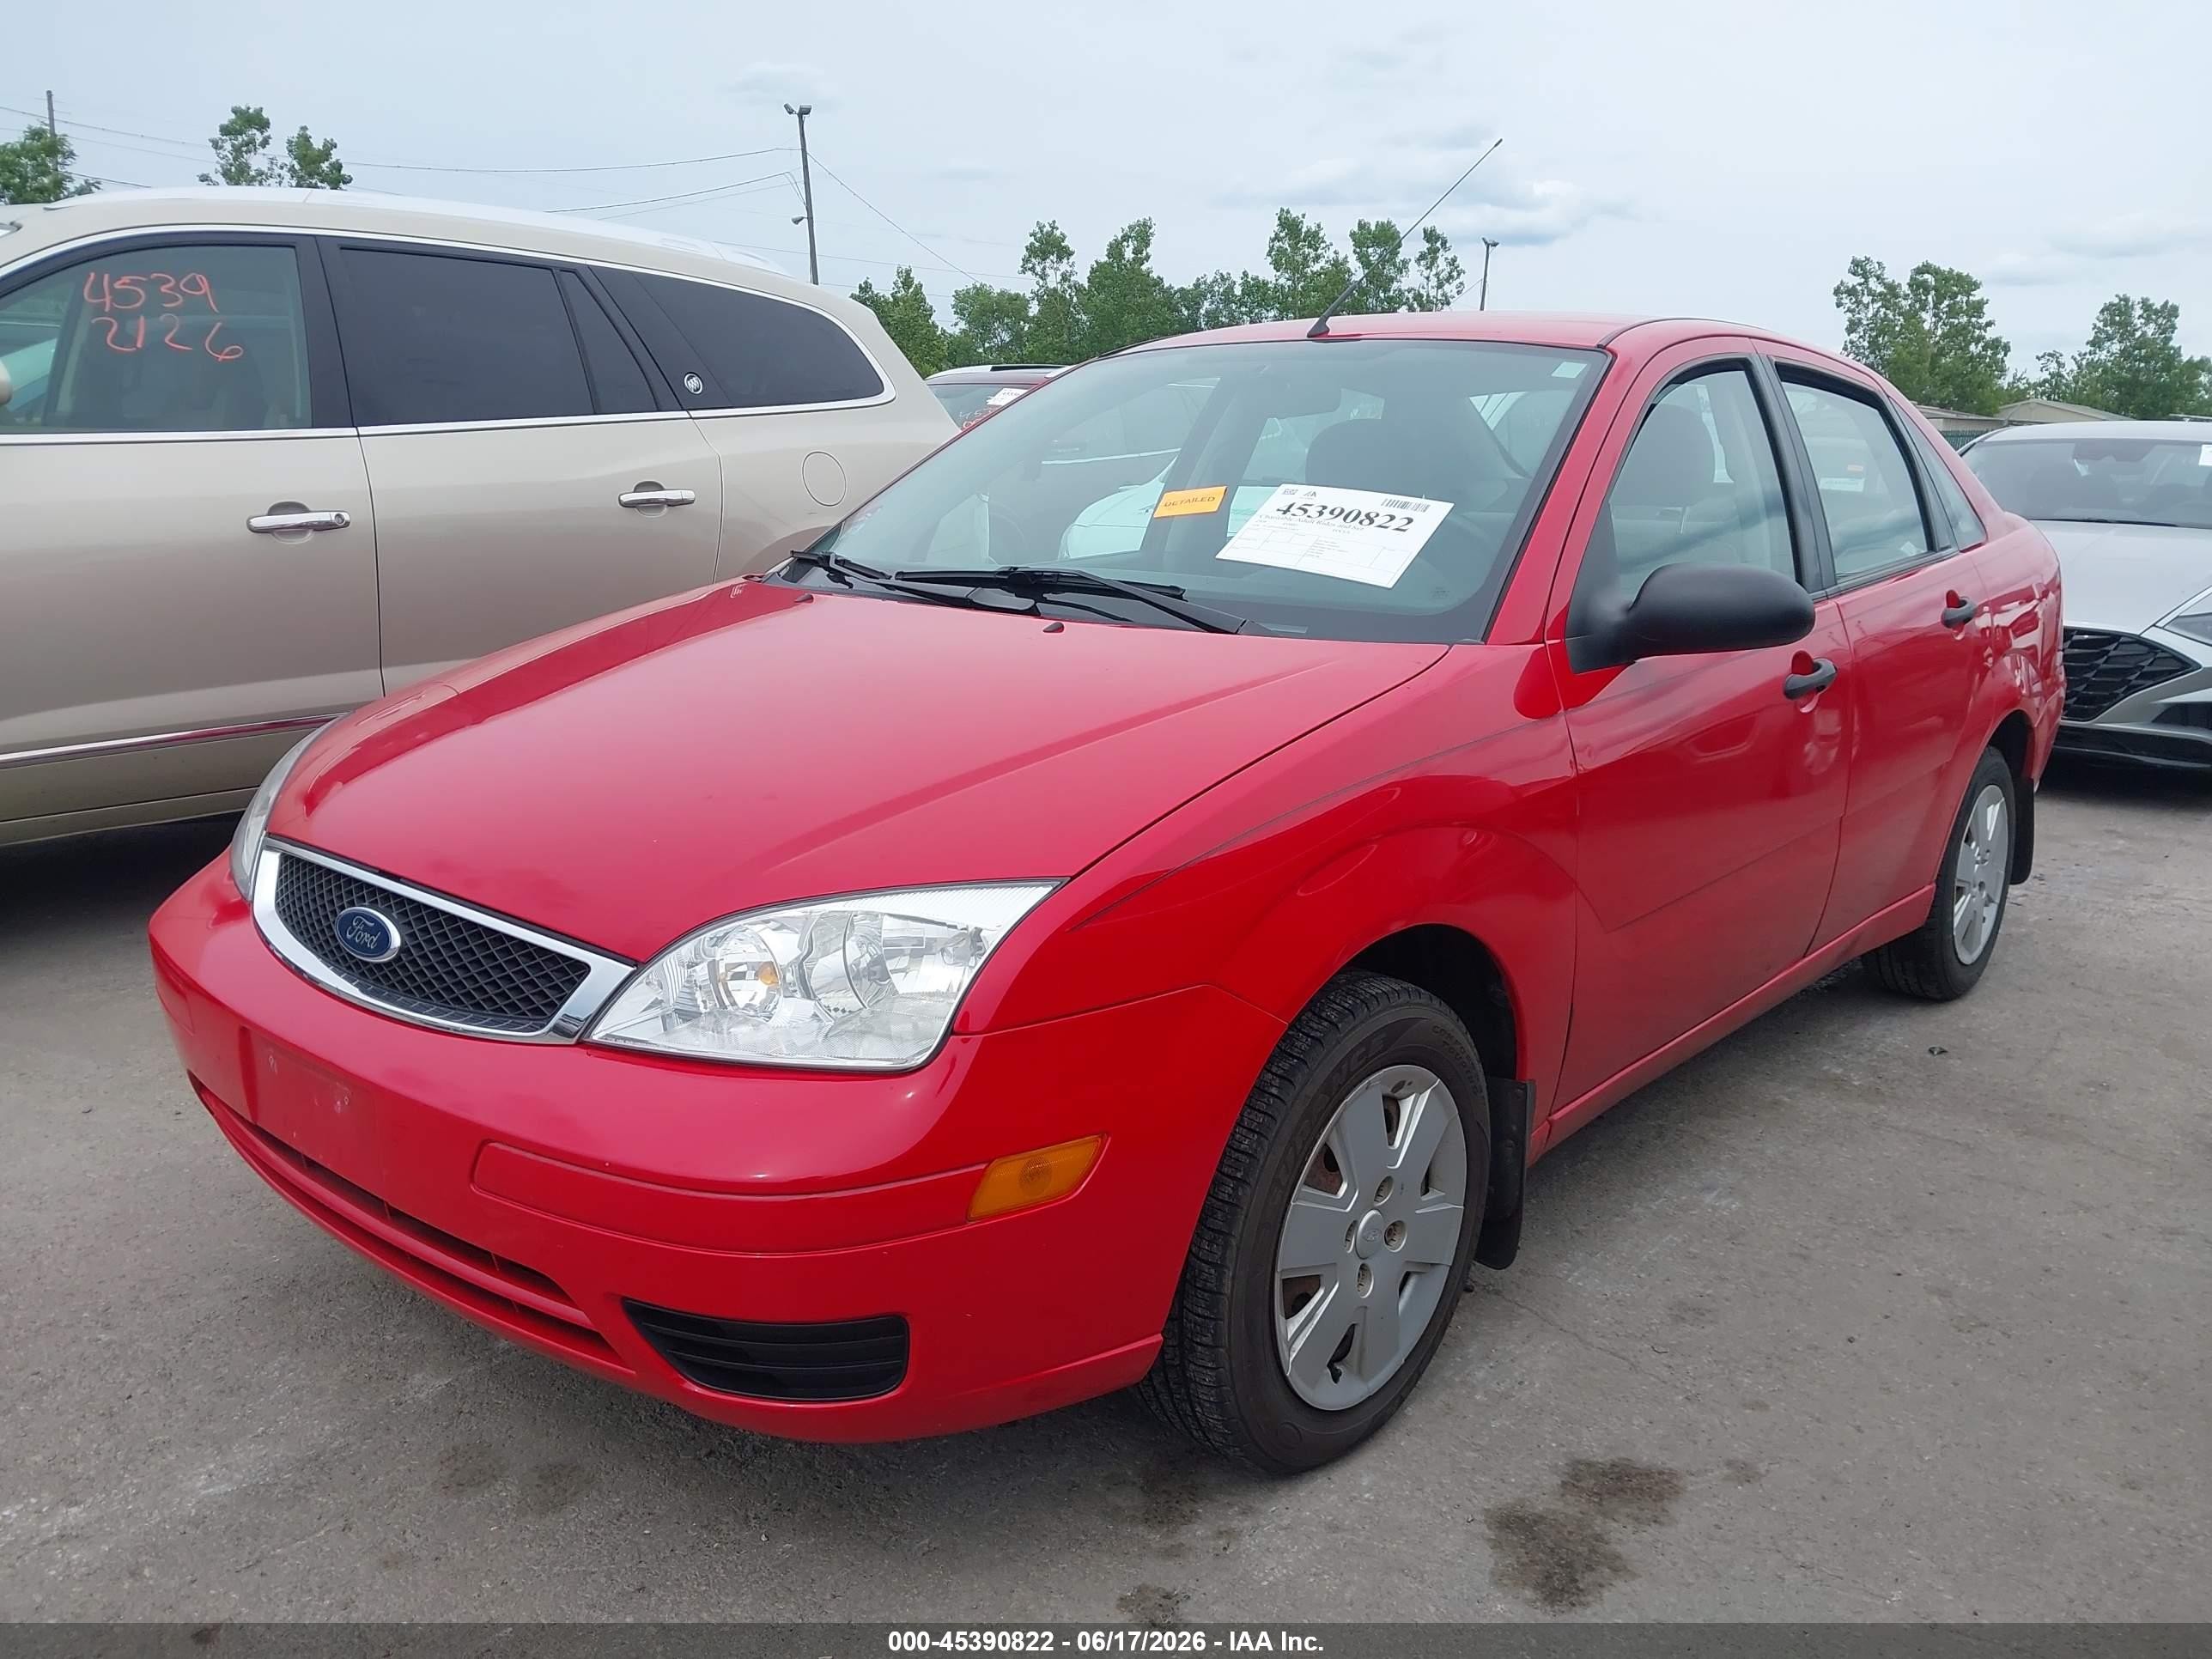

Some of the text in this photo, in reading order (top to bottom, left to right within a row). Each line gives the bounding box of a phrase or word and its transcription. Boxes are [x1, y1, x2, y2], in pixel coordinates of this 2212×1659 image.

[83, 272, 220, 313] 4539
[91, 313, 244, 362] 2126
[1164, 496, 1216, 507] DETAILED
[1275, 501, 1414, 532] 45390822
[346, 915, 381, 949] Ford
